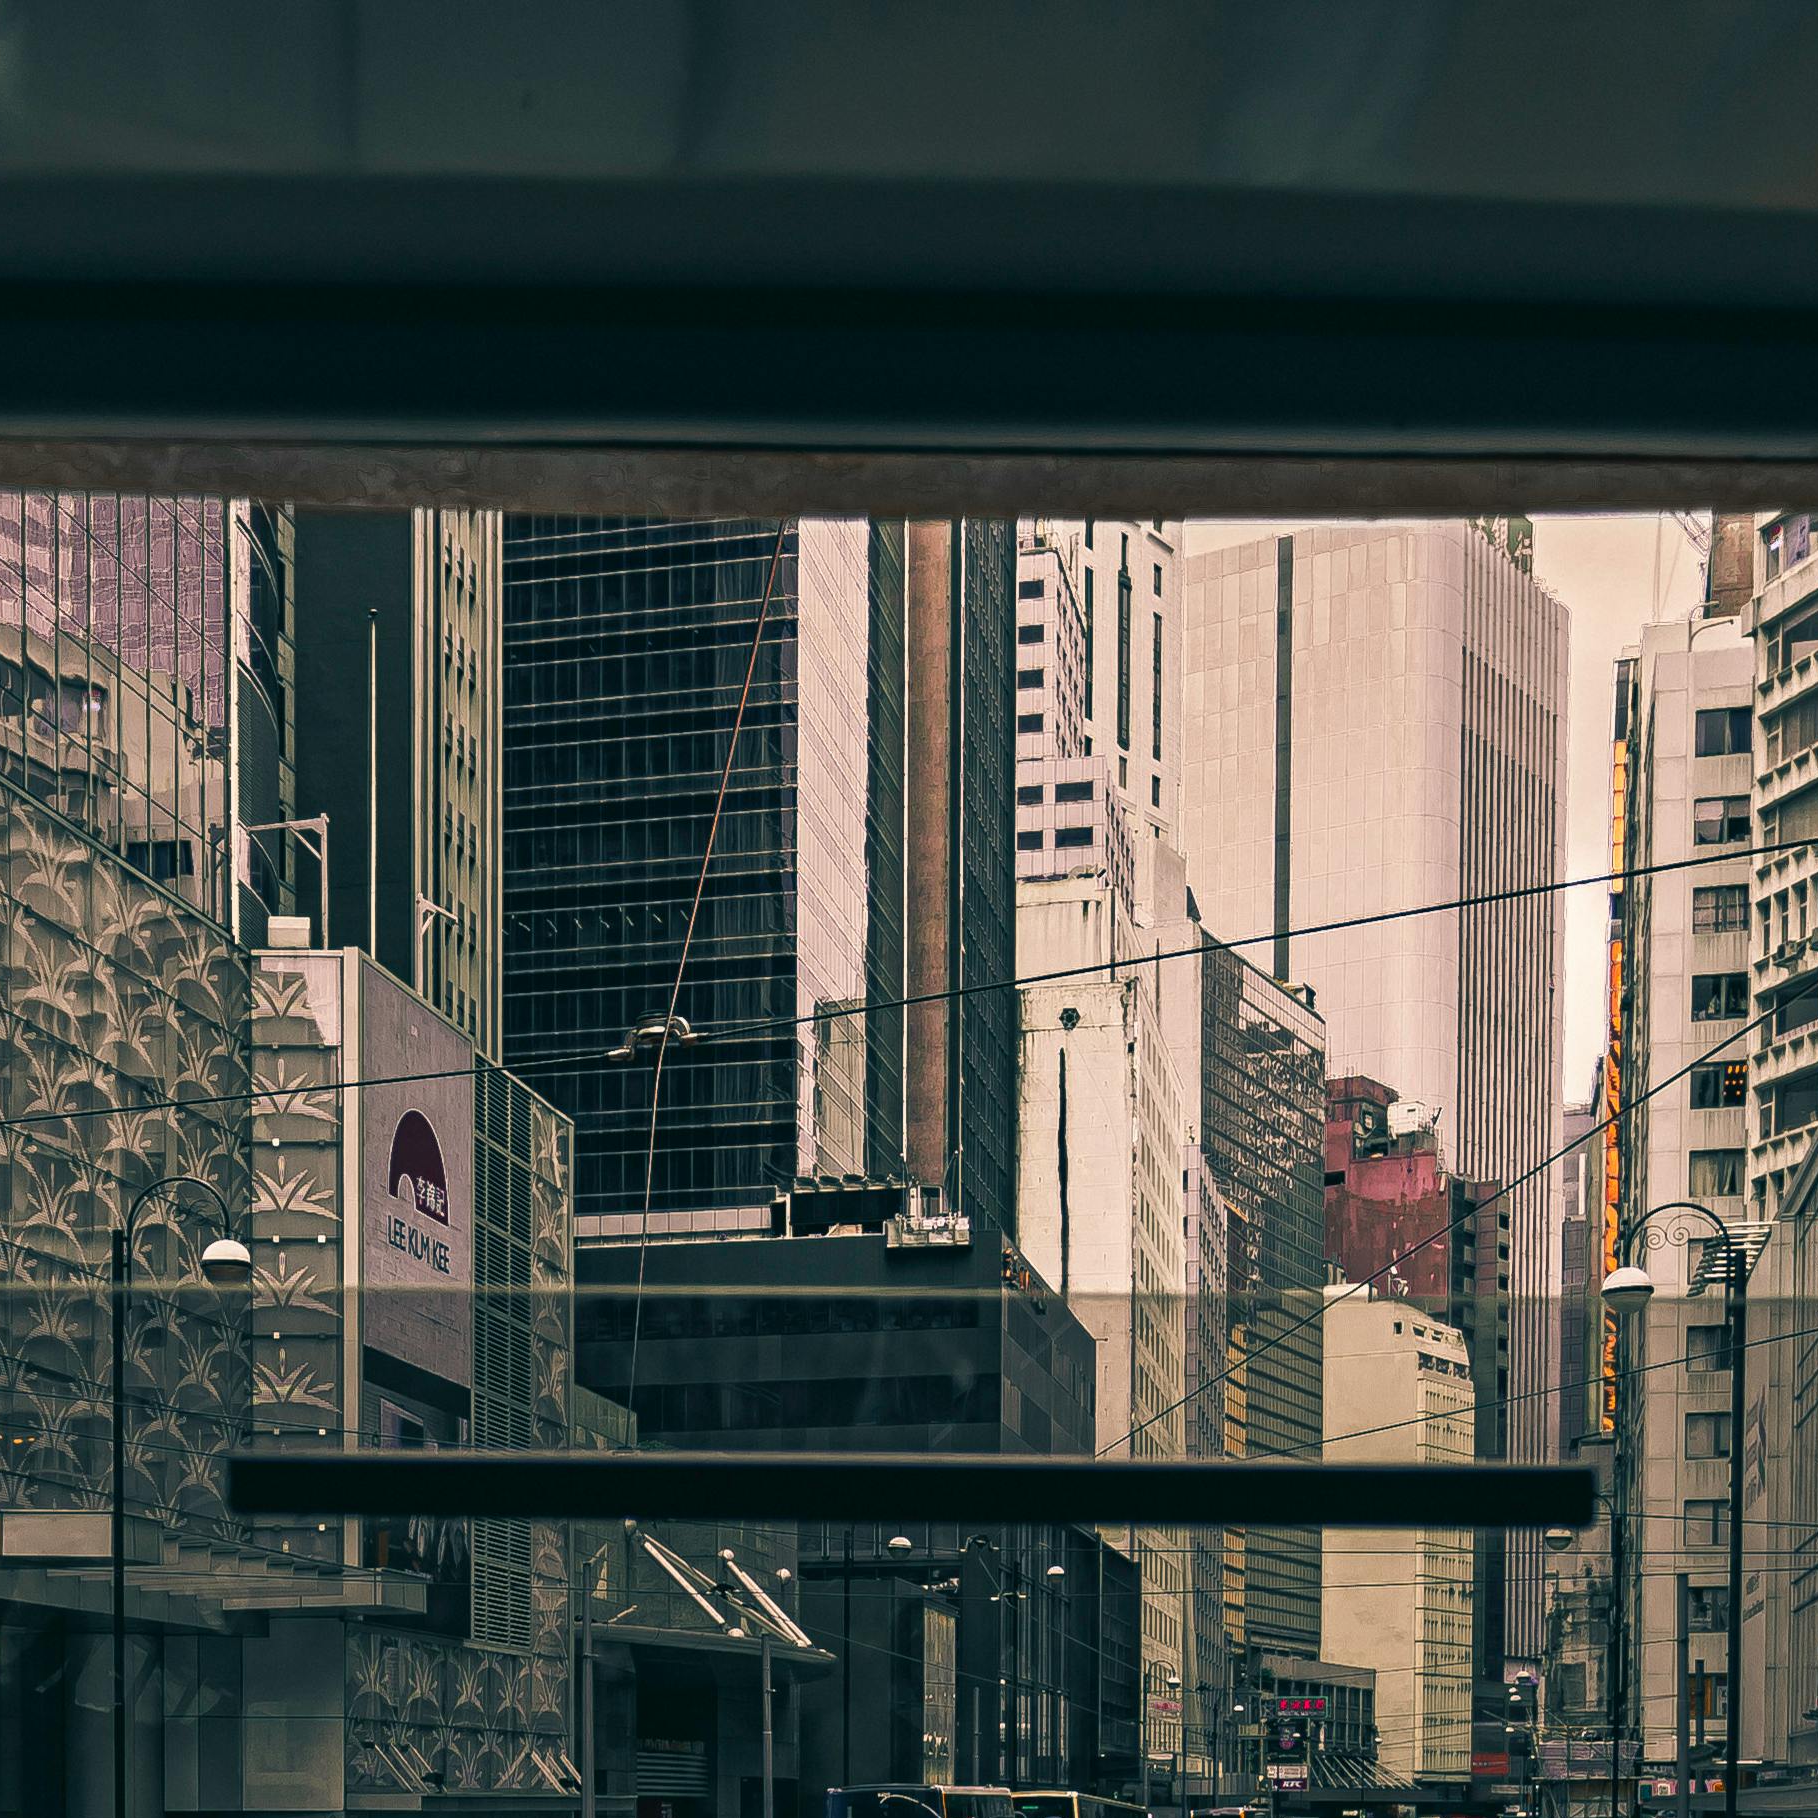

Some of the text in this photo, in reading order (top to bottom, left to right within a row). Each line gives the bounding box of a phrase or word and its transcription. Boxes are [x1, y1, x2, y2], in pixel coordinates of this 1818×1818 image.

[387, 1214, 451, 1275] LEE KUM KEE
